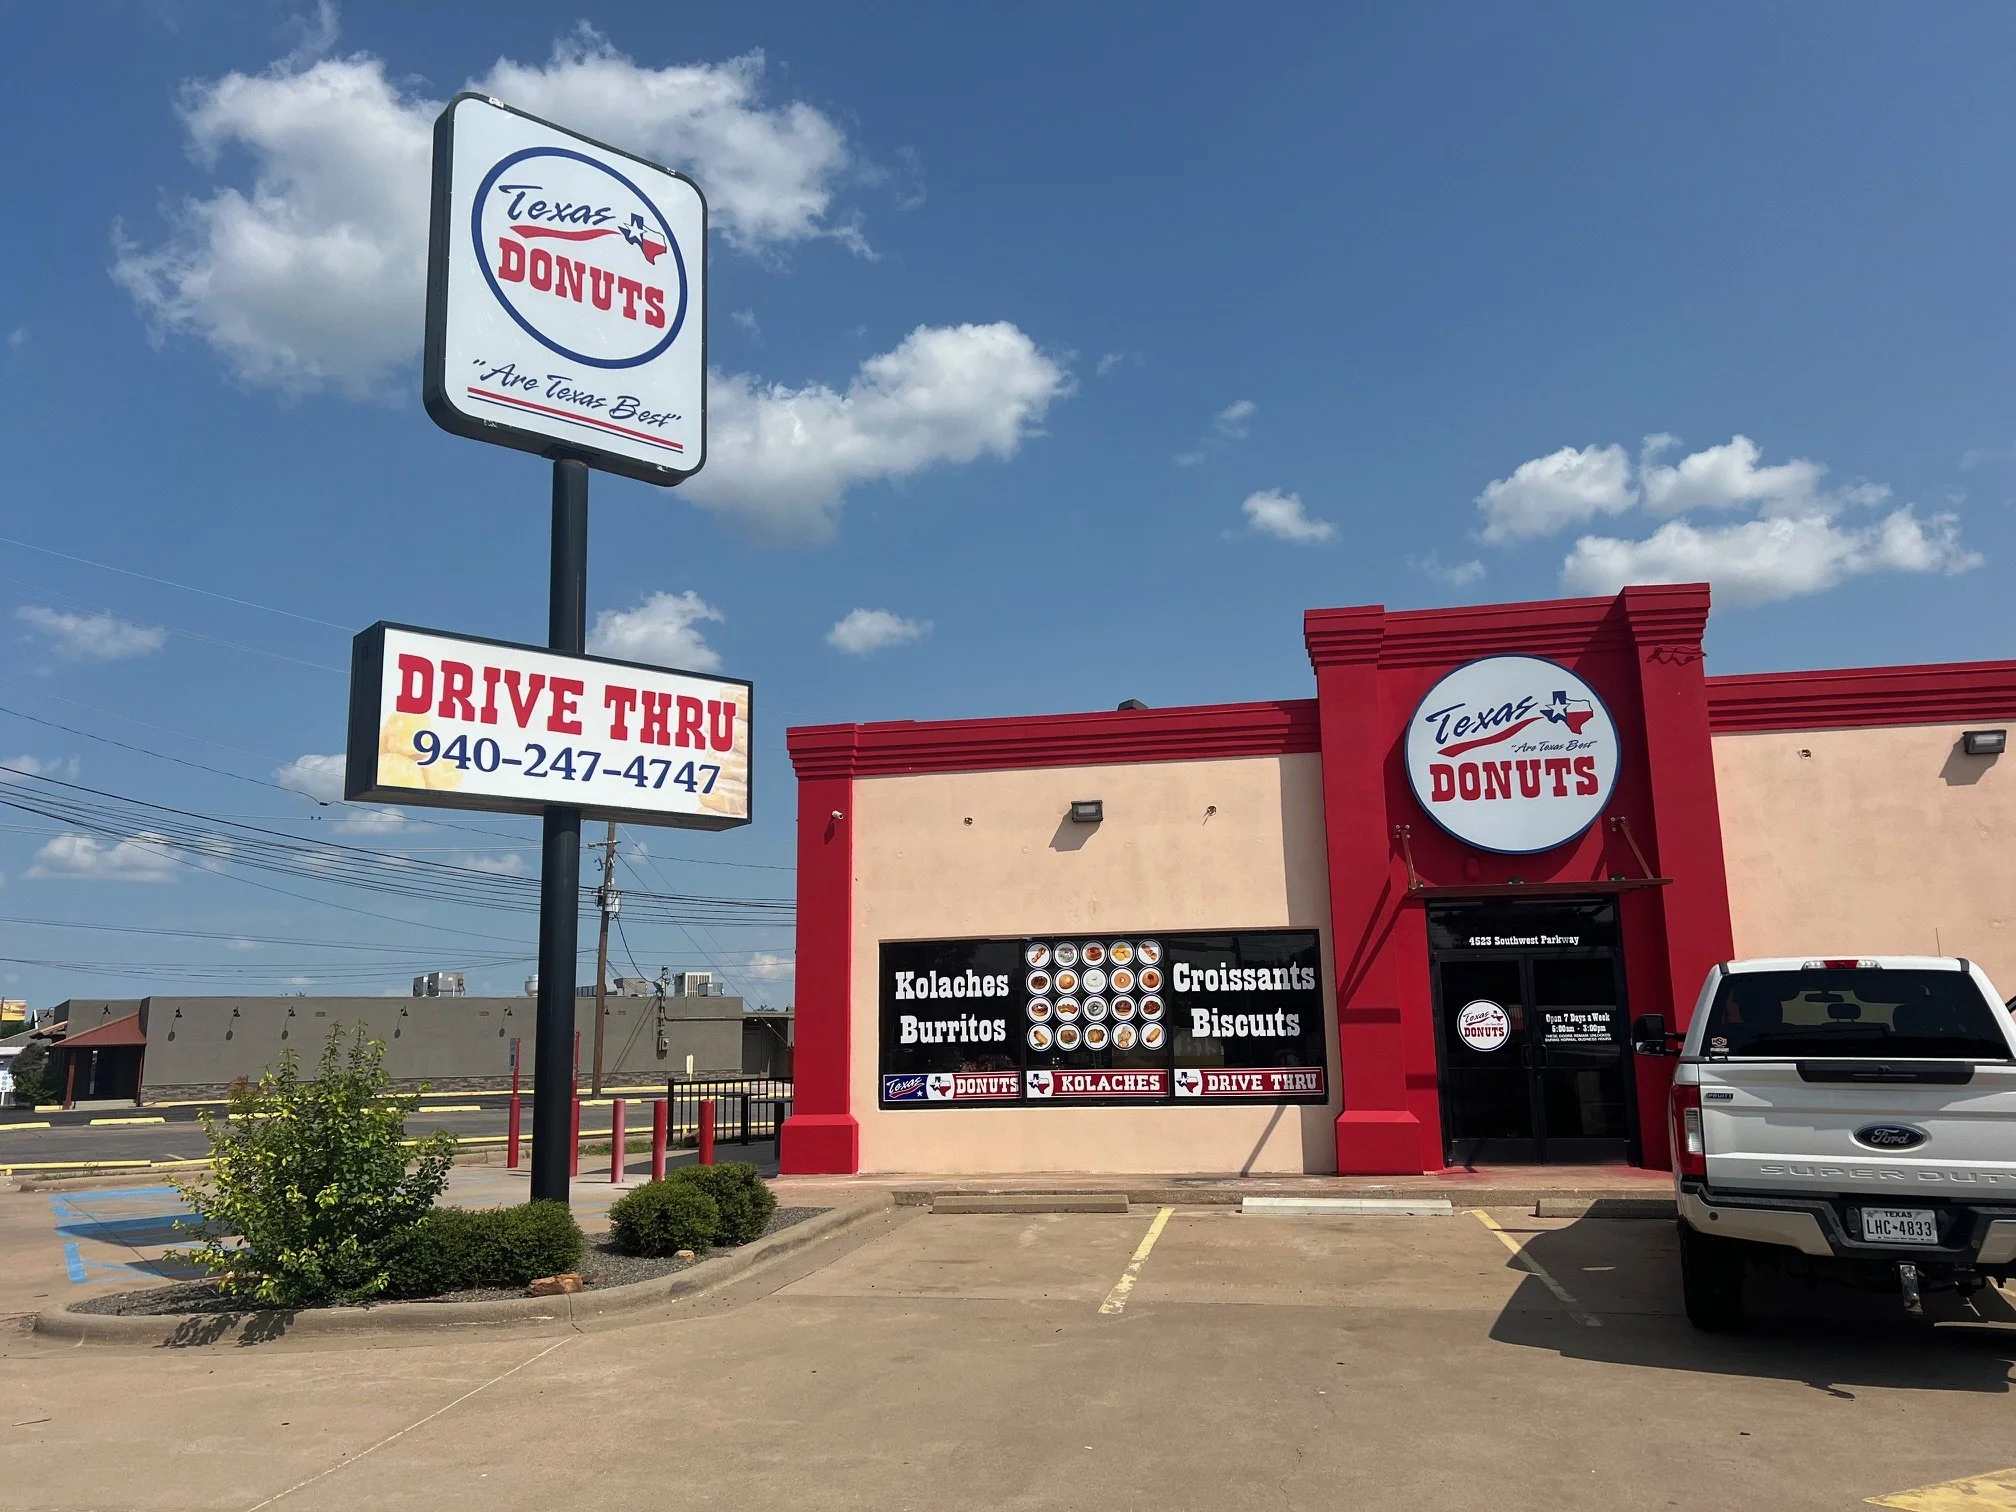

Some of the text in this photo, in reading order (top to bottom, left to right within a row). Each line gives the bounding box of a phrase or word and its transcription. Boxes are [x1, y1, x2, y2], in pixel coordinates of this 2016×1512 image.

[498, 184, 617, 225] Texas
[497, 236, 666, 329] DONUTS
[546, 374, 608, 409] Texas
[395, 653, 736, 752] DRIVE THRU
[1425, 695, 1539, 745] Texas
[1539, 740, 1565, 752] Texas
[412, 729, 721, 795] 940-247-4747
[1429, 755, 1599, 803] DONUTS
[1468, 934, 1580, 946] 4523 Southwest Parkway
[895, 968, 1010, 1000] Kolaches
[1173, 961, 1316, 993] Croissants
[1190, 1007, 1301, 1038] Biscuits
[1463, 1011, 1490, 1023] Texas
[1545, 1013, 1562, 1024] Open
[1563, 1013, 1569, 1022] 7
[1570, 1012, 1586, 1024] Days
[1591, 1012, 1610, 1022] Week
[900, 1013, 1006, 1044] Burritos
[1464, 1027, 1504, 1037] DONUTS
[886, 1076, 924, 1095] Texas
[956, 1077, 1019, 1095] DONUTS
[1061, 1073, 1161, 1092] KOLACHES
[1207, 1073, 1317, 1091] DRIVE THRU
[1870, 1128, 1910, 1144] Ford
[1760, 1164, 2016, 1184] SUPER DUT
[1899, 1220, 1932, 1237] 4833
